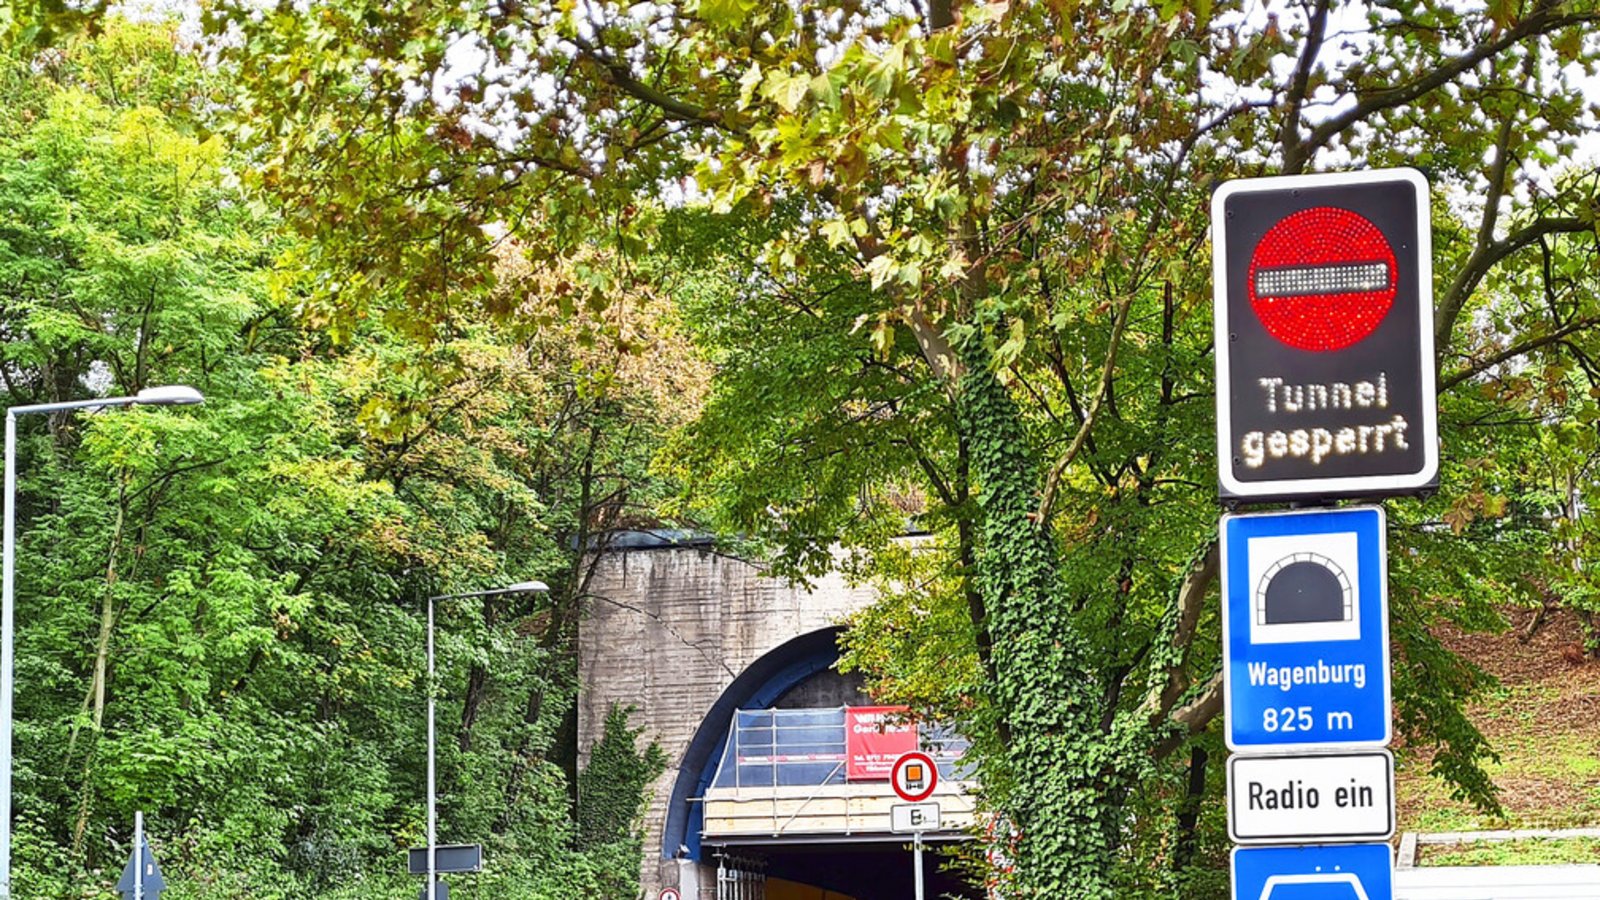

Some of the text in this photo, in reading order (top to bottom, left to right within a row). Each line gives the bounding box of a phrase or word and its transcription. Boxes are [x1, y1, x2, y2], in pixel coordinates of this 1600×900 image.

[1258, 372, 1388, 413] Tunnel
[1241, 414, 1409, 468] gesperrt
[1247, 659, 1366, 692] Wagenburg
[1263, 706, 1353, 733] 825 m
[1248, 778, 1373, 810] Radio ein
